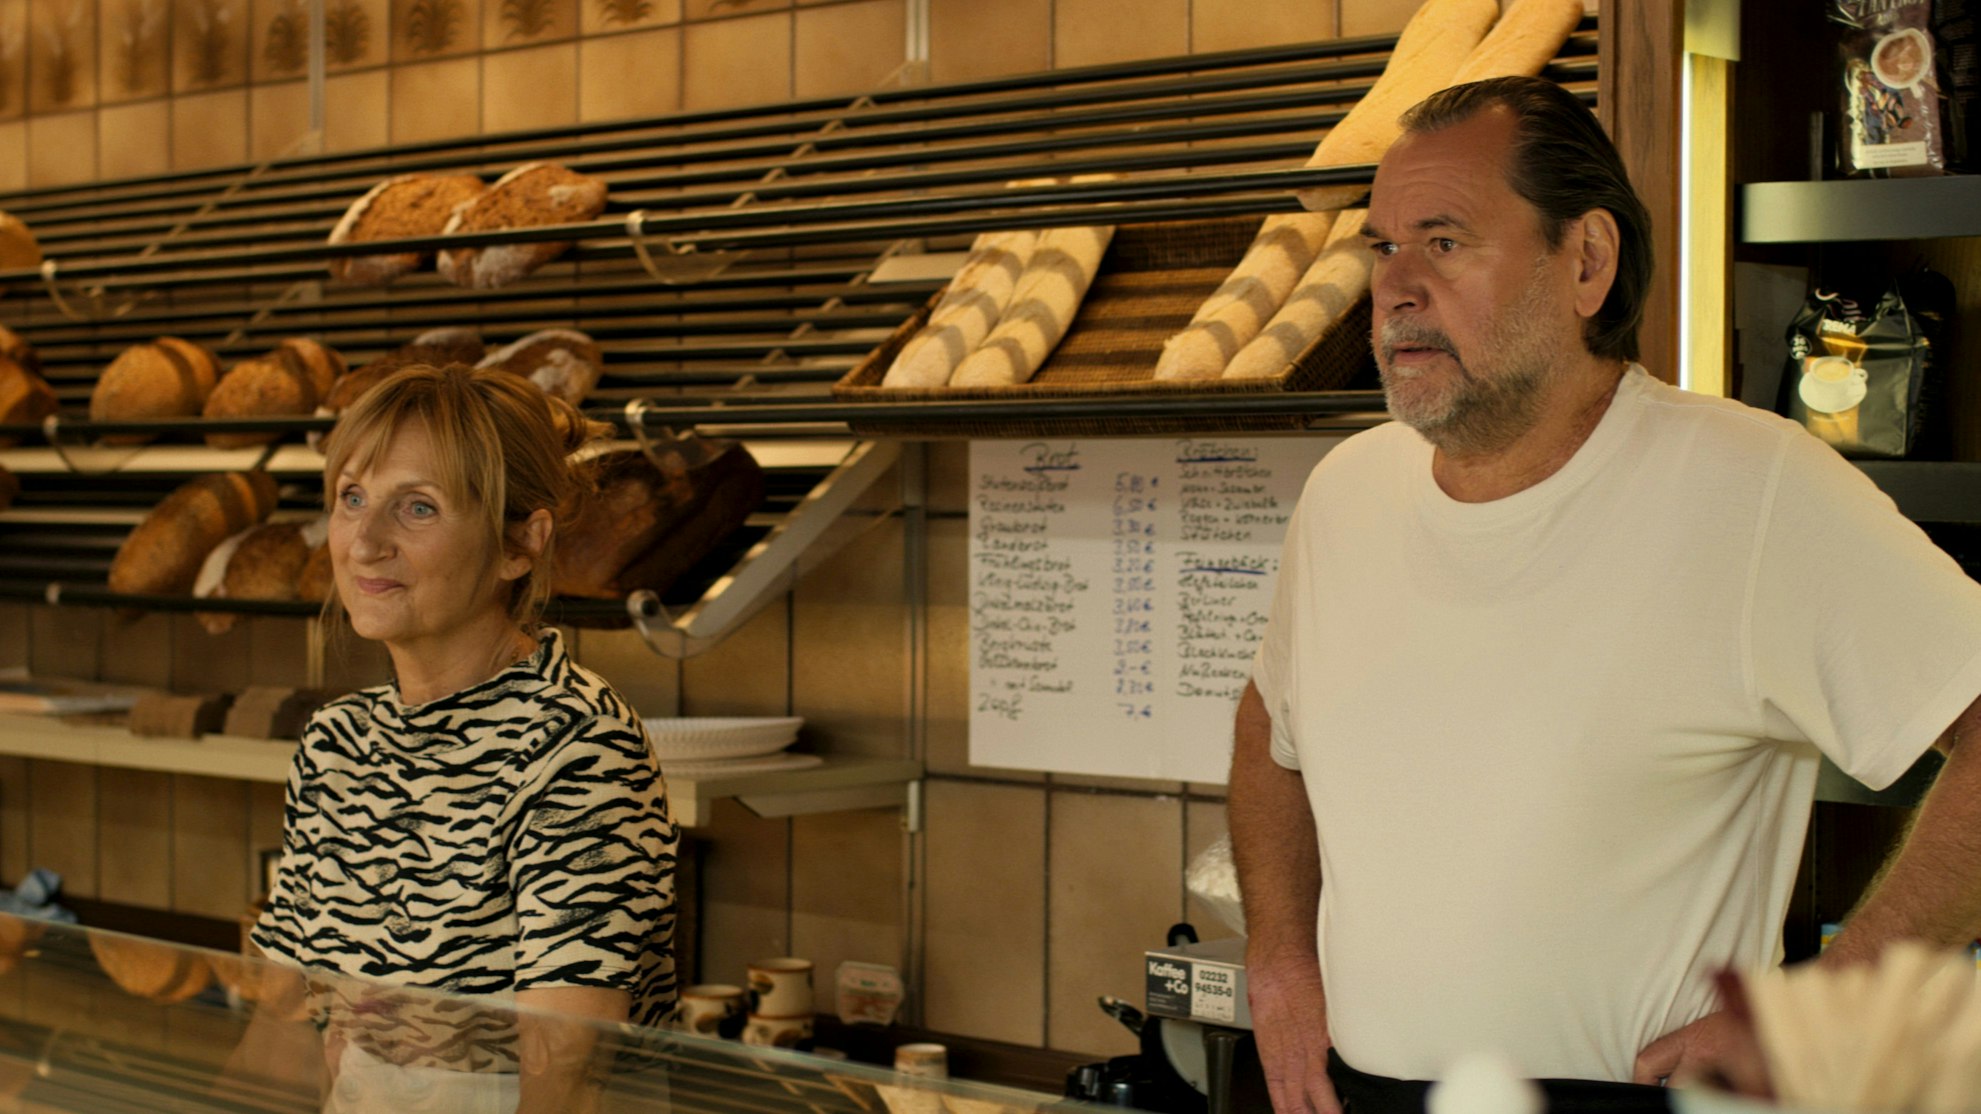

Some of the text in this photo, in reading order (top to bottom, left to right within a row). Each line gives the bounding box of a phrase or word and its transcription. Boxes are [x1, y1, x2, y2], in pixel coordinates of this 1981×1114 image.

[1020, 443, 1079, 466] Brot
[1148, 961, 1187, 980] Kaffee
[1200, 969, 1229, 983] 02232
[1164, 980, 1189, 995] +Co
